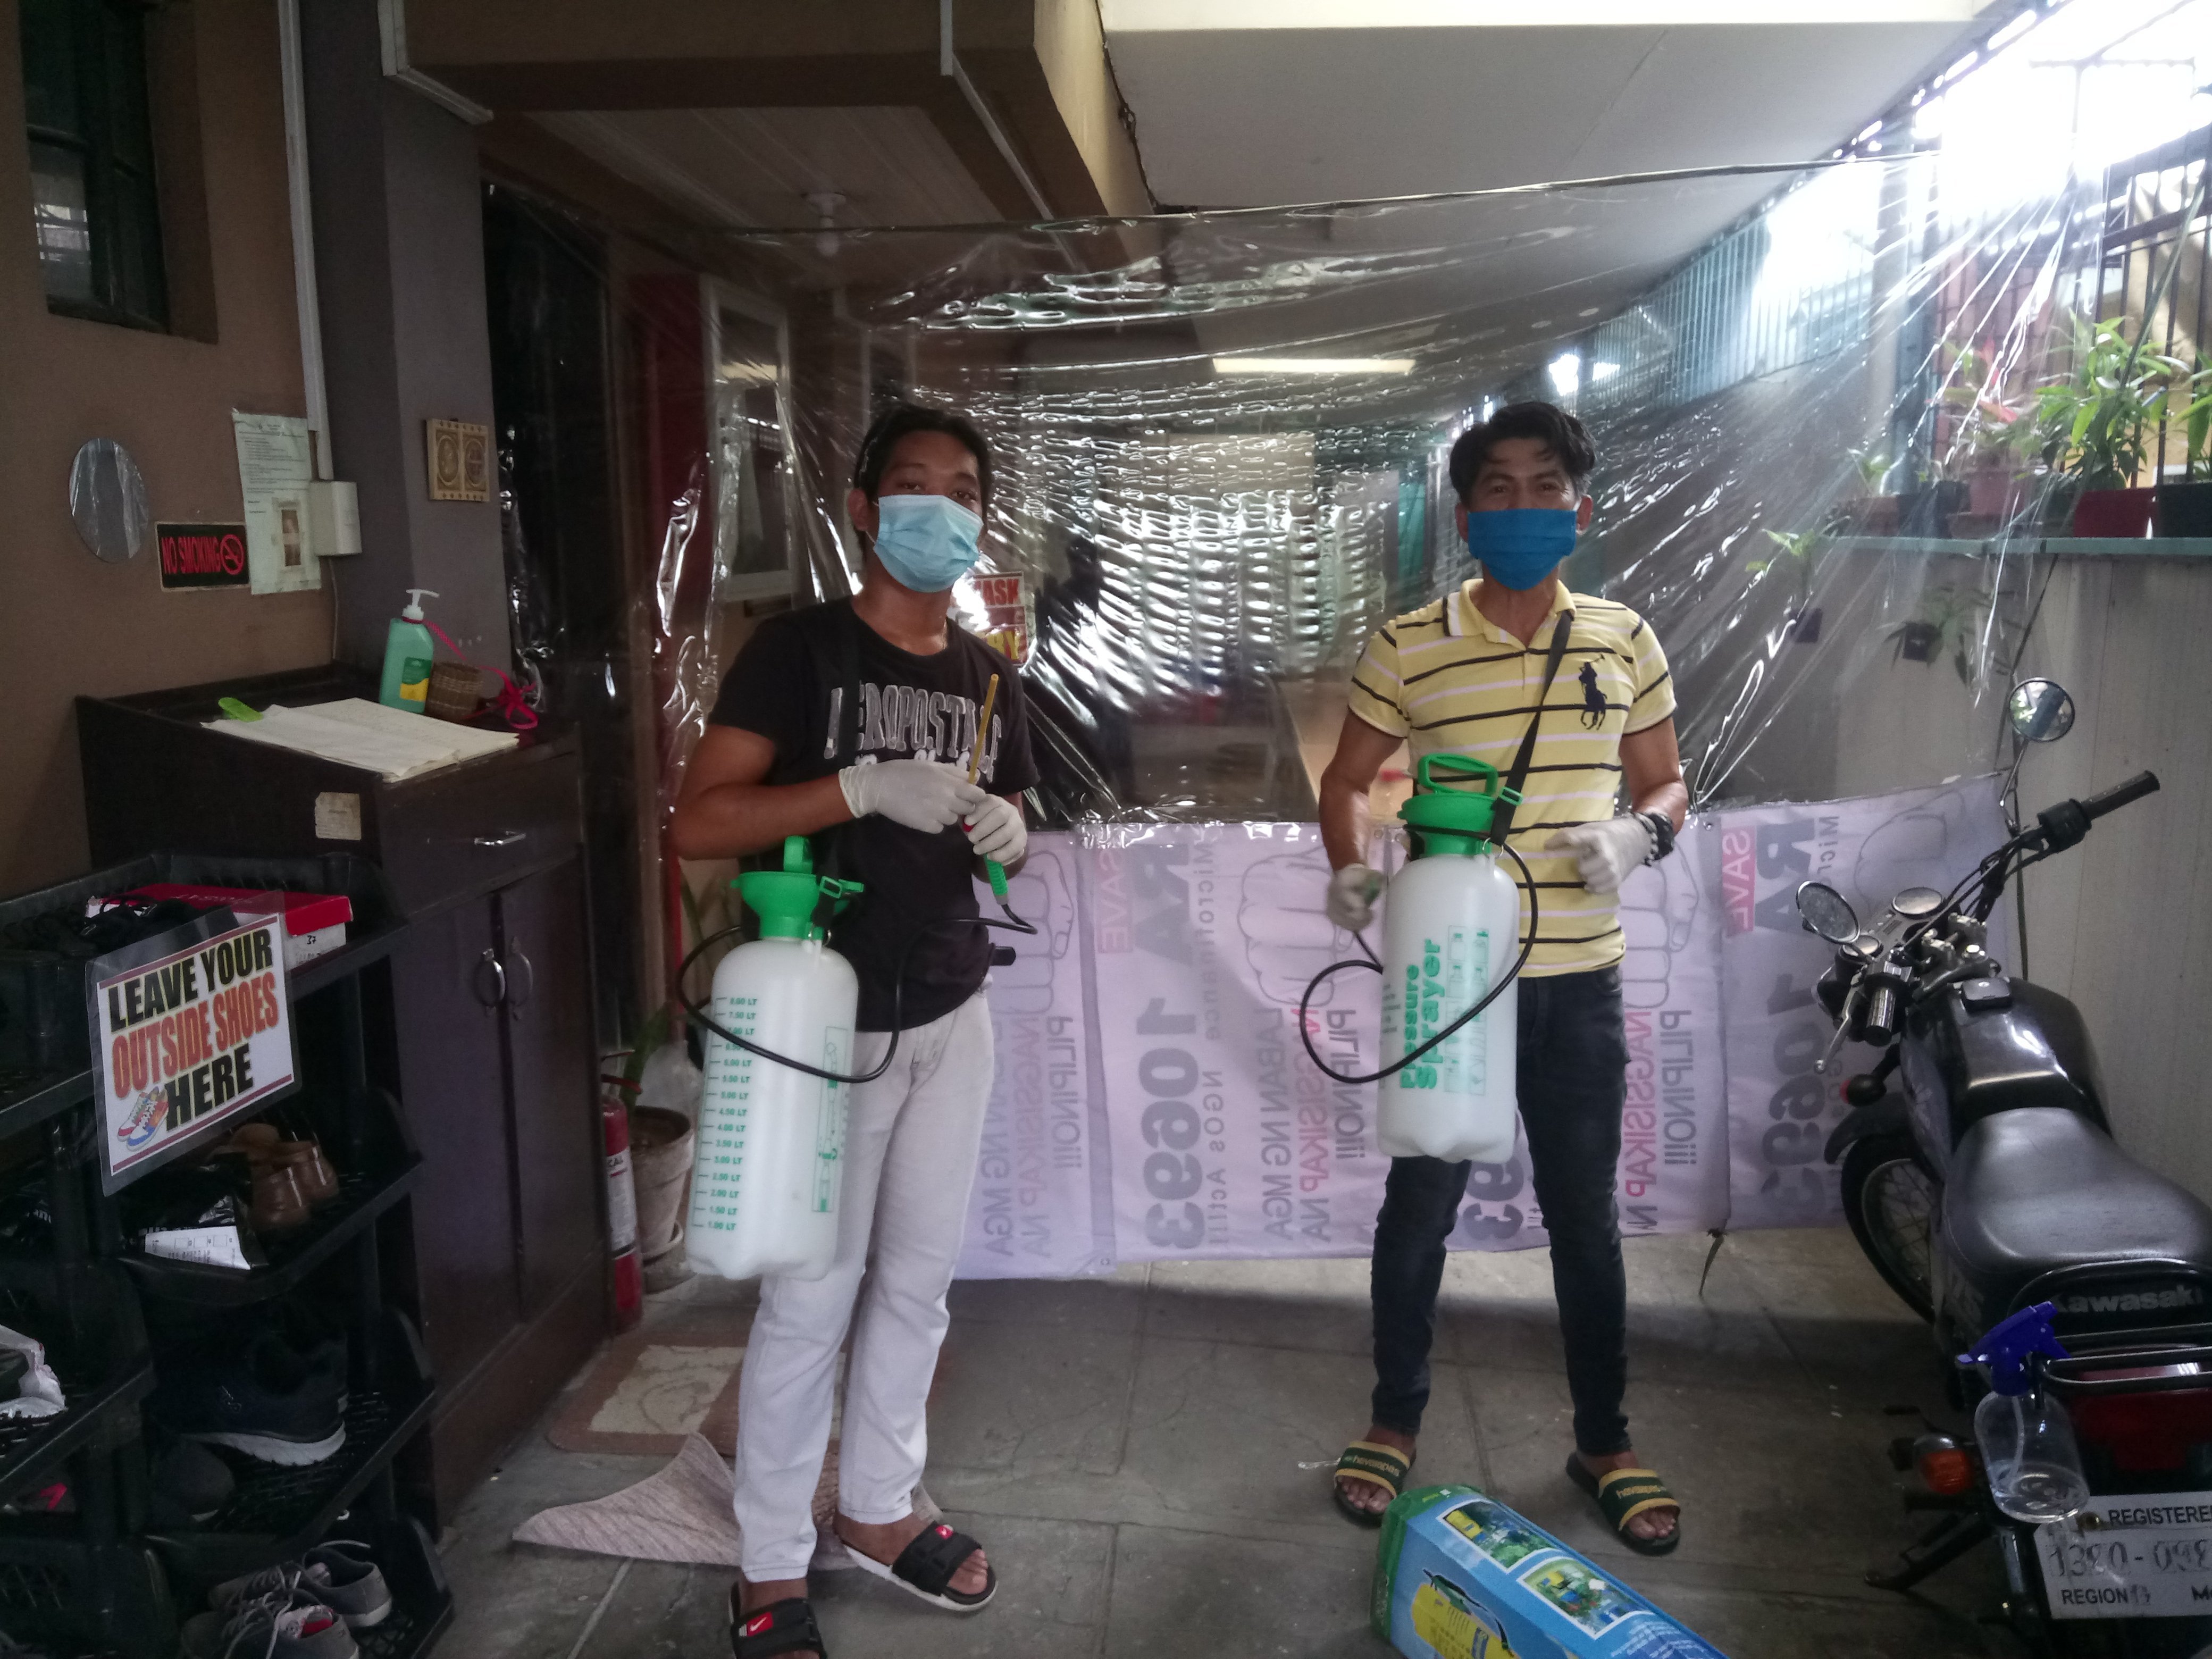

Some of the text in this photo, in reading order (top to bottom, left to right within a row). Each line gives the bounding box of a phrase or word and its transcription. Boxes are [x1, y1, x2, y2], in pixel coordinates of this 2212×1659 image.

[161, 536, 221, 575] NO SMOKING
[108, 929, 273, 1033] LEAVE YOUR
[306, 935, 317, 945] 37
[112, 971, 279, 1100] OUTSIDE SHOES
[1400, 965, 1419, 1088] Pressure
[1415, 939, 1445, 1088] Sprayer
[165, 1043, 255, 1132] HERE
[2108, 1505, 2212, 1526] REGISTERE
[2061, 1587, 2129, 1604] REGION
[2191, 1585, 2212, 1601] M
